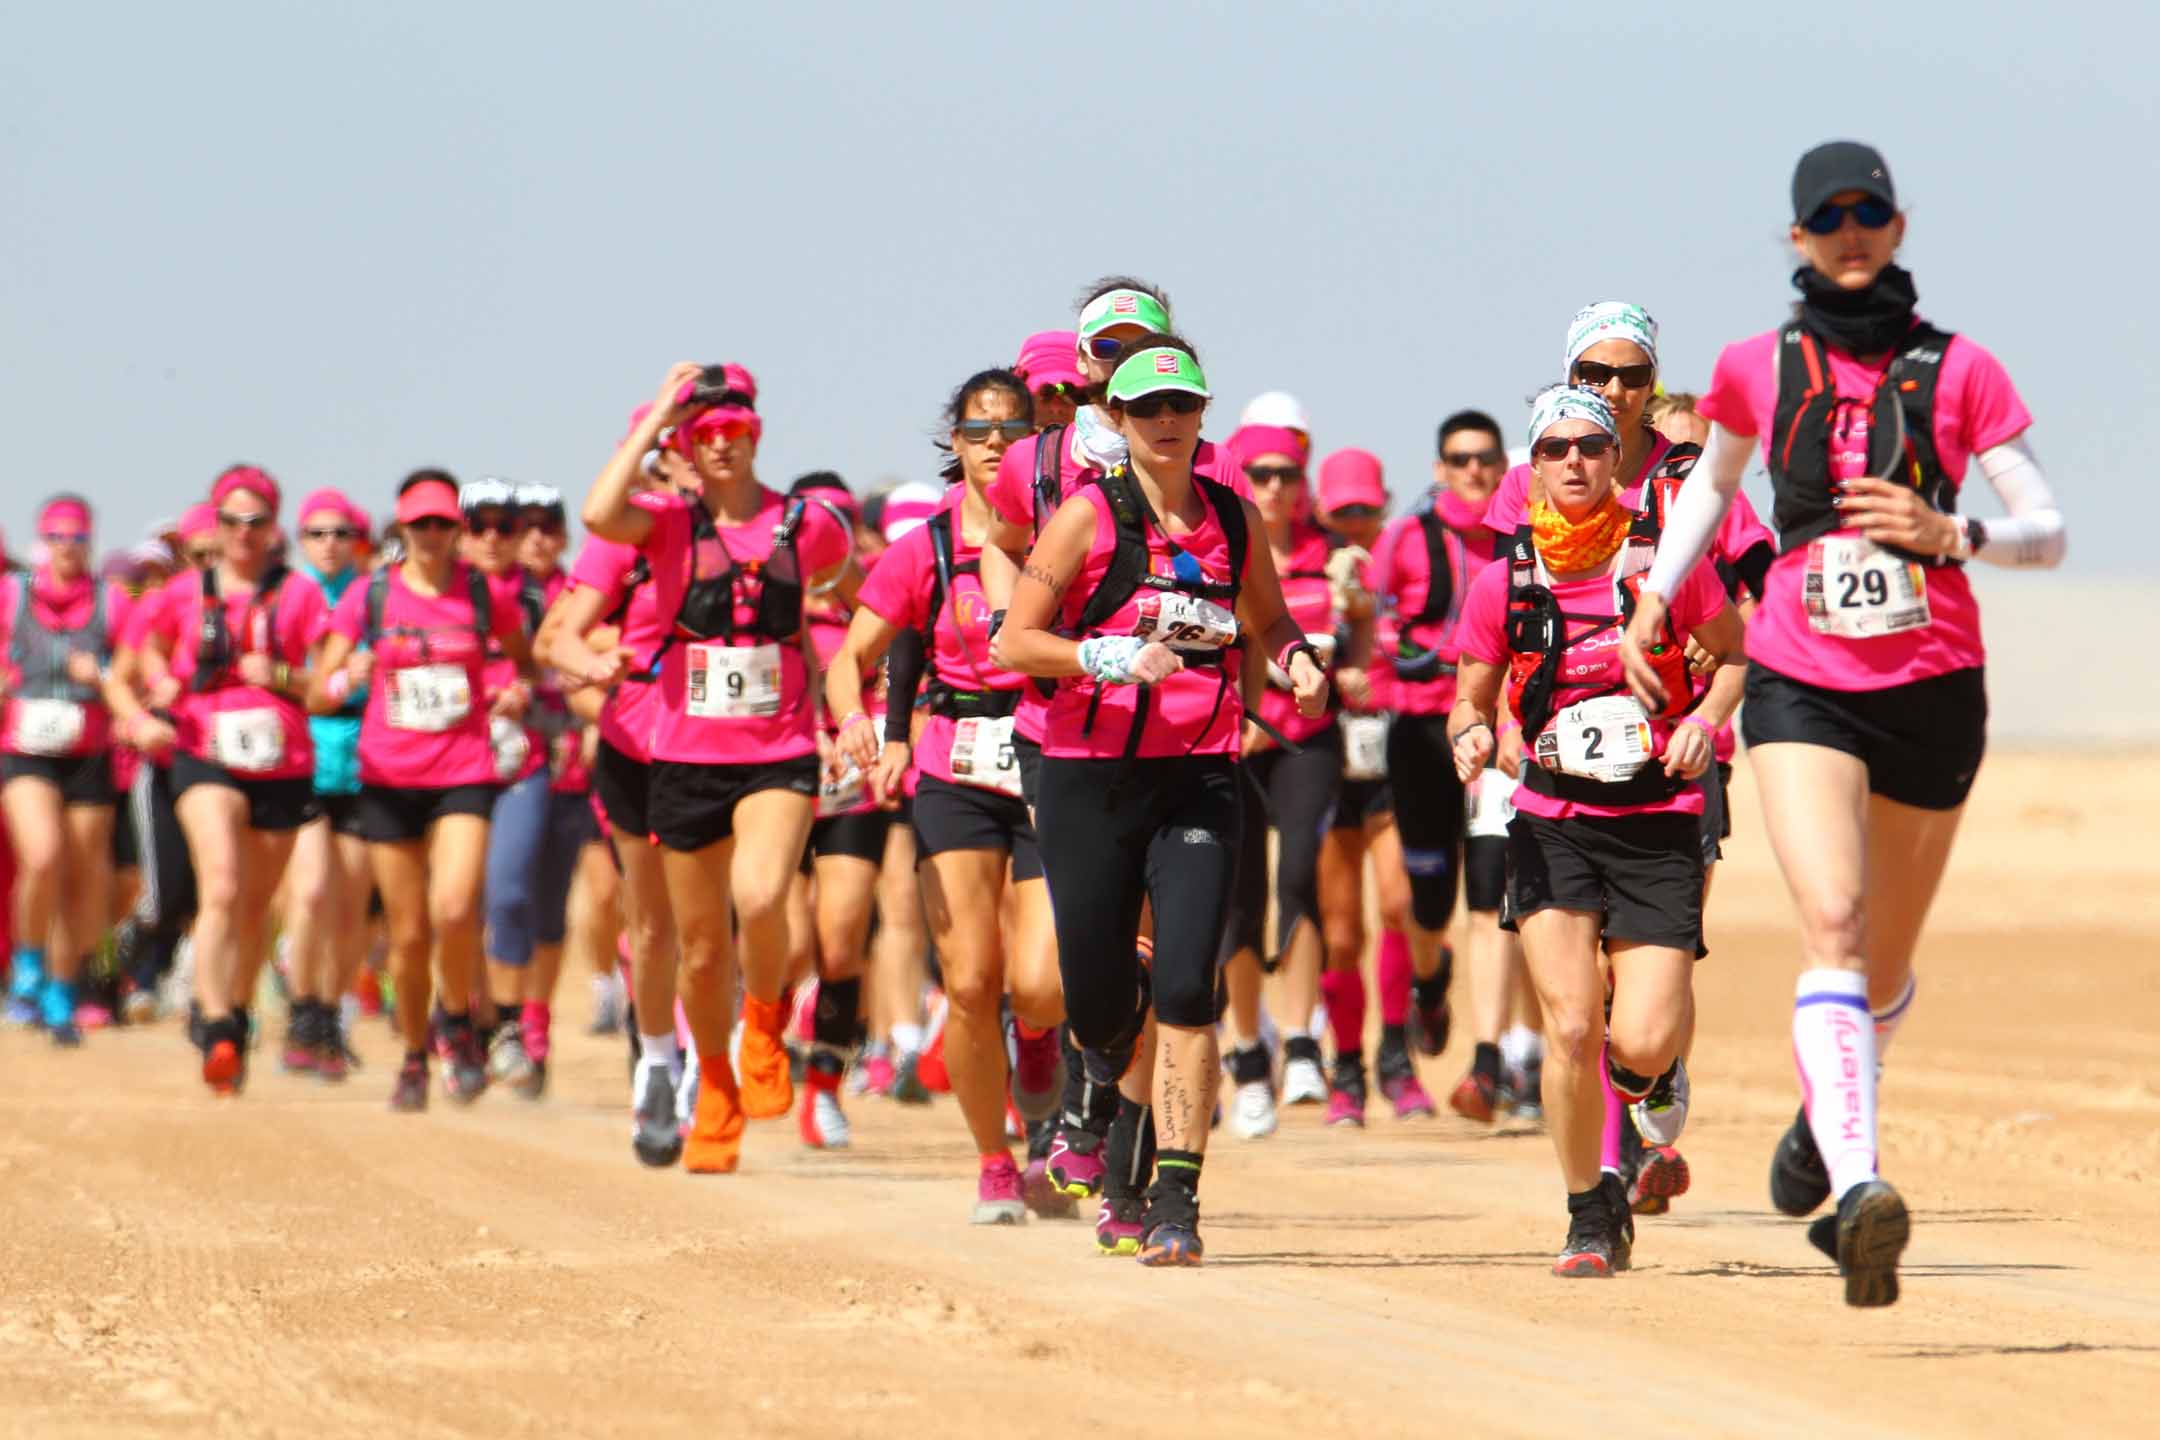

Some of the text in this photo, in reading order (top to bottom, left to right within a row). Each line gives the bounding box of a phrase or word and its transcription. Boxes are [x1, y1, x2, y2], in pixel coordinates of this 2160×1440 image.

[1837, 568, 1889, 609] 29
[726, 671, 744, 698] 9
[1581, 726, 1605, 761] 2
[1826, 1009, 1863, 1140] Kalenji
